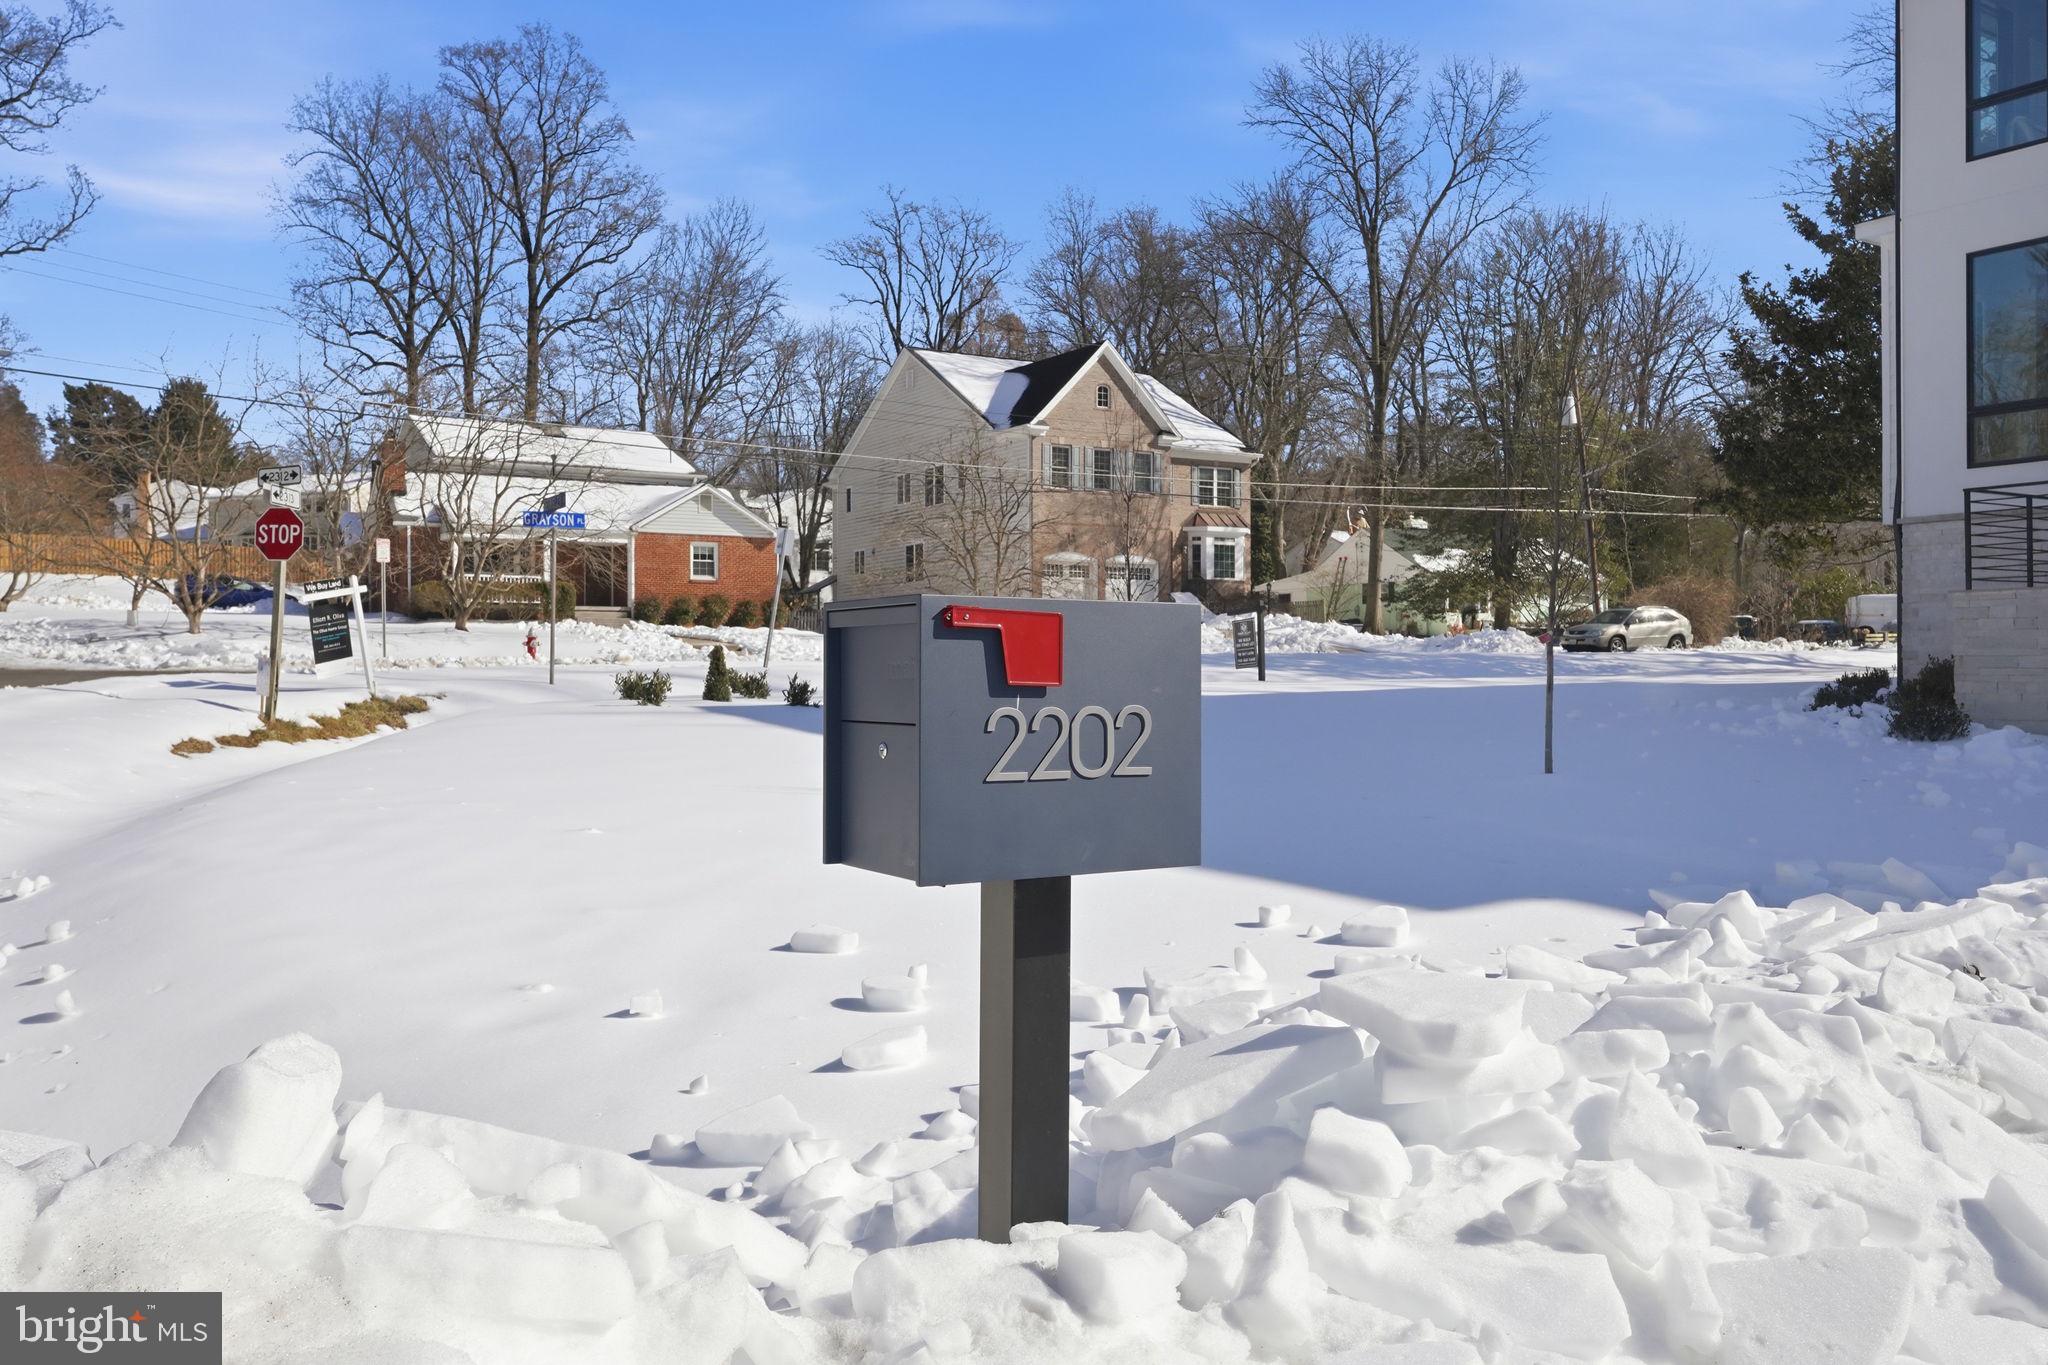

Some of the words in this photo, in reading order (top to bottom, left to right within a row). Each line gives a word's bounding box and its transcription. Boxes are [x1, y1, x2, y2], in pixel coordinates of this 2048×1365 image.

[269, 471, 289, 482] 2312
[524, 512, 574, 526] GRAYSON
[258, 524, 301, 545] STOP
[985, 704, 1153, 783] 2202
